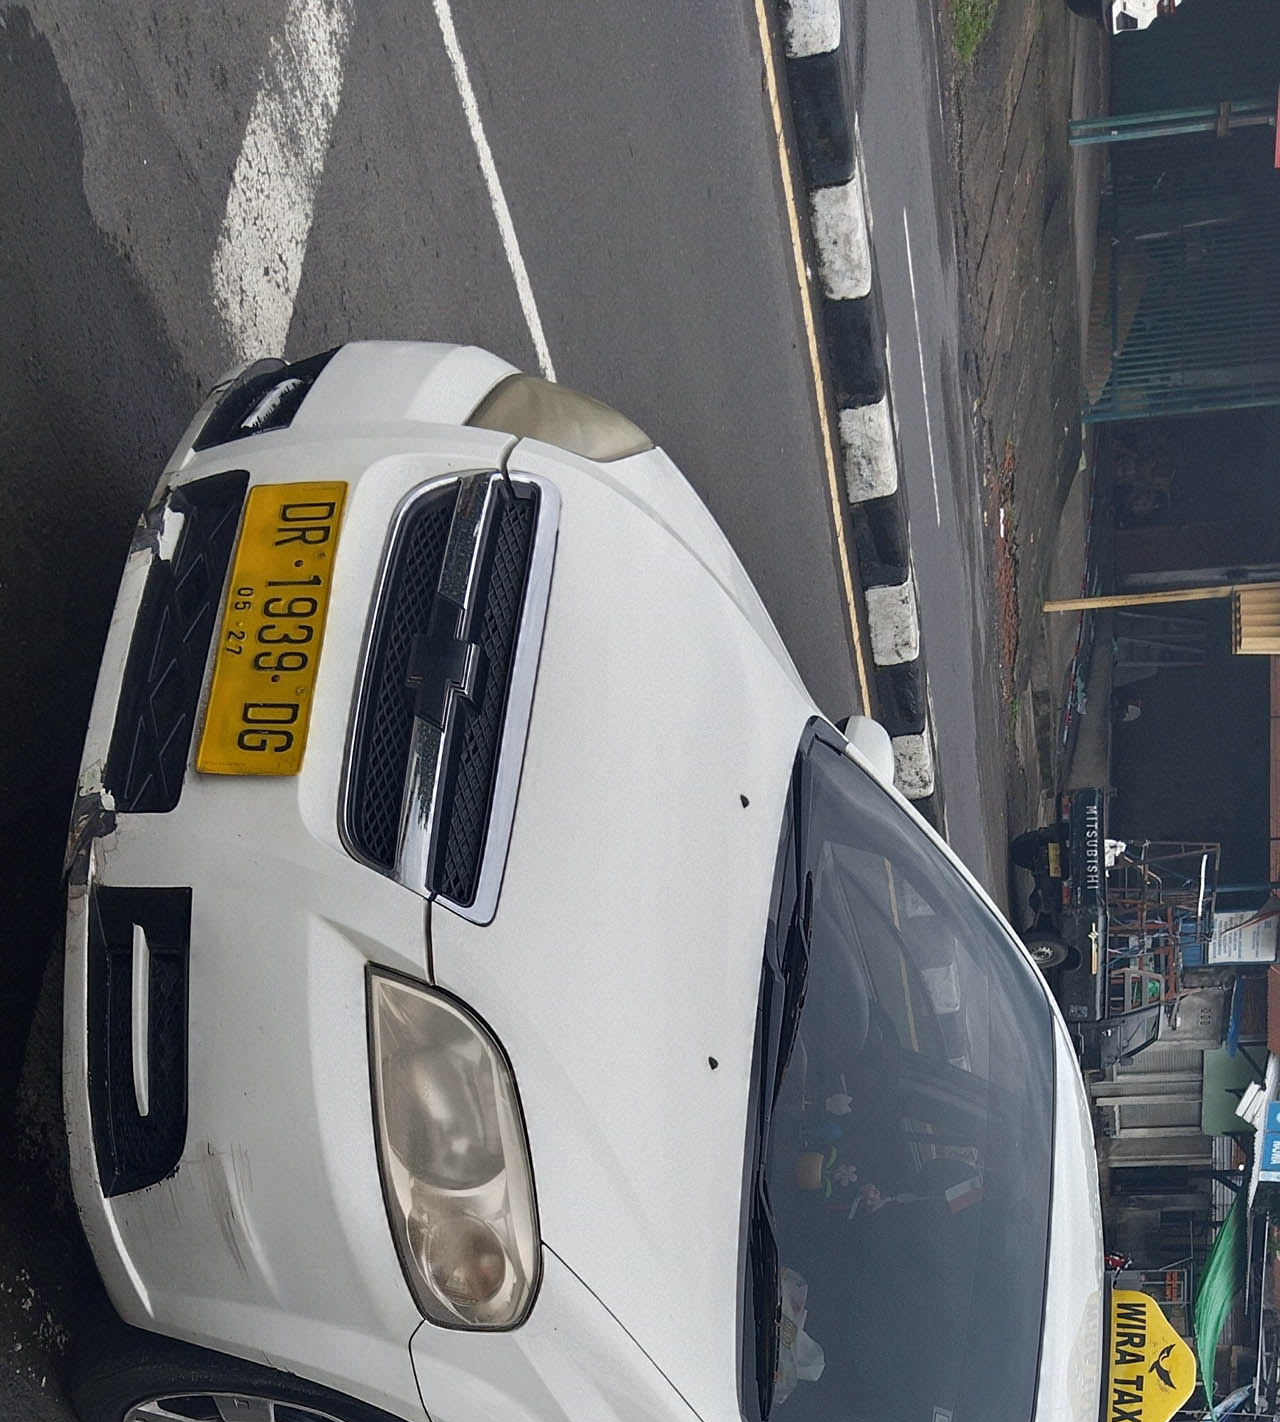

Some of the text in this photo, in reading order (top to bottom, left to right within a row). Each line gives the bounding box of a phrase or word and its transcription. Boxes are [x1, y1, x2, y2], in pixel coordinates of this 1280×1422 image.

[225, 630, 245, 656] 27
[237, 502, 336, 753] DR 1939 DG
[1085, 806, 1099, 891] MITSUBISHI
[1114, 1303, 1146, 1365] WIRA
